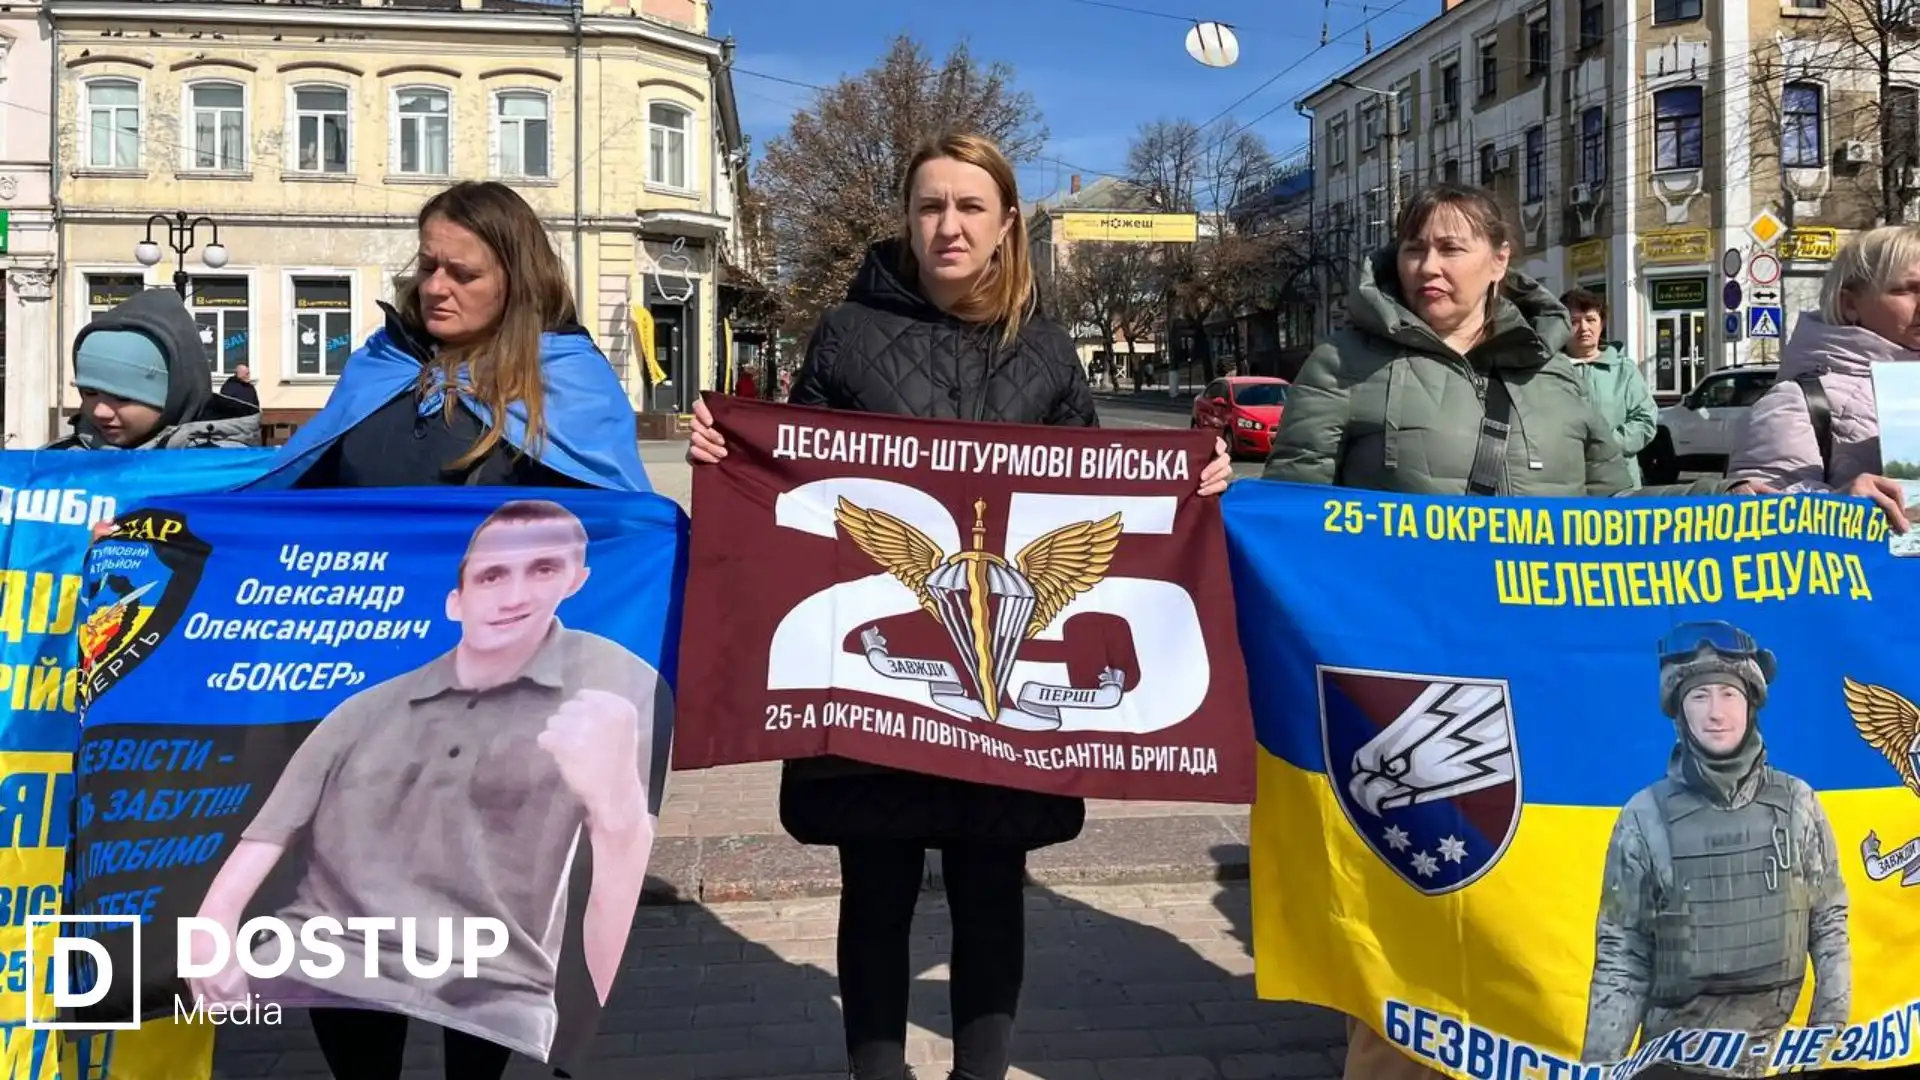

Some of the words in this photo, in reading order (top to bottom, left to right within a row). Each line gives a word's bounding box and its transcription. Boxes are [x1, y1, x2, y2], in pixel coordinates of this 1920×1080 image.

[772, 423, 1073, 478] ДЕСАНТНО-ШТУРМОВІ
[1080, 442, 1189, 481] ВІЙСЬКА
[1324, 499, 1418, 540] 25-ТА
[1425, 504, 1555, 546] ОКРЕМА
[1562, 495, 1863, 546] ПОВІТРЯНОДЕСАНТНА
[279, 544, 388, 577] Червяк
[1494, 557, 1724, 607] ШЕЛЕПЕНКО
[1731, 549, 1872, 603] ЕДУАРД
[235, 578, 404, 611] Олександр
[767, 476, 1211, 734] 25
[184, 612, 430, 647] Олександрович
[207, 662, 366, 691] «БОКСЕР»
[887, 660, 948, 678] ЗАВЖДИ
[1039, 687, 1097, 703] ПЕРШІ
[765, 703, 817, 730] 25-А
[822, 702, 906, 738] ОКРЕМА
[911, 717, 1126, 772] ПОВІТРЯНО-ДЕСАНТНА
[1131, 744, 1218, 774] БРИГАДА
[1771, 1029, 1834, 1067] НЕ
